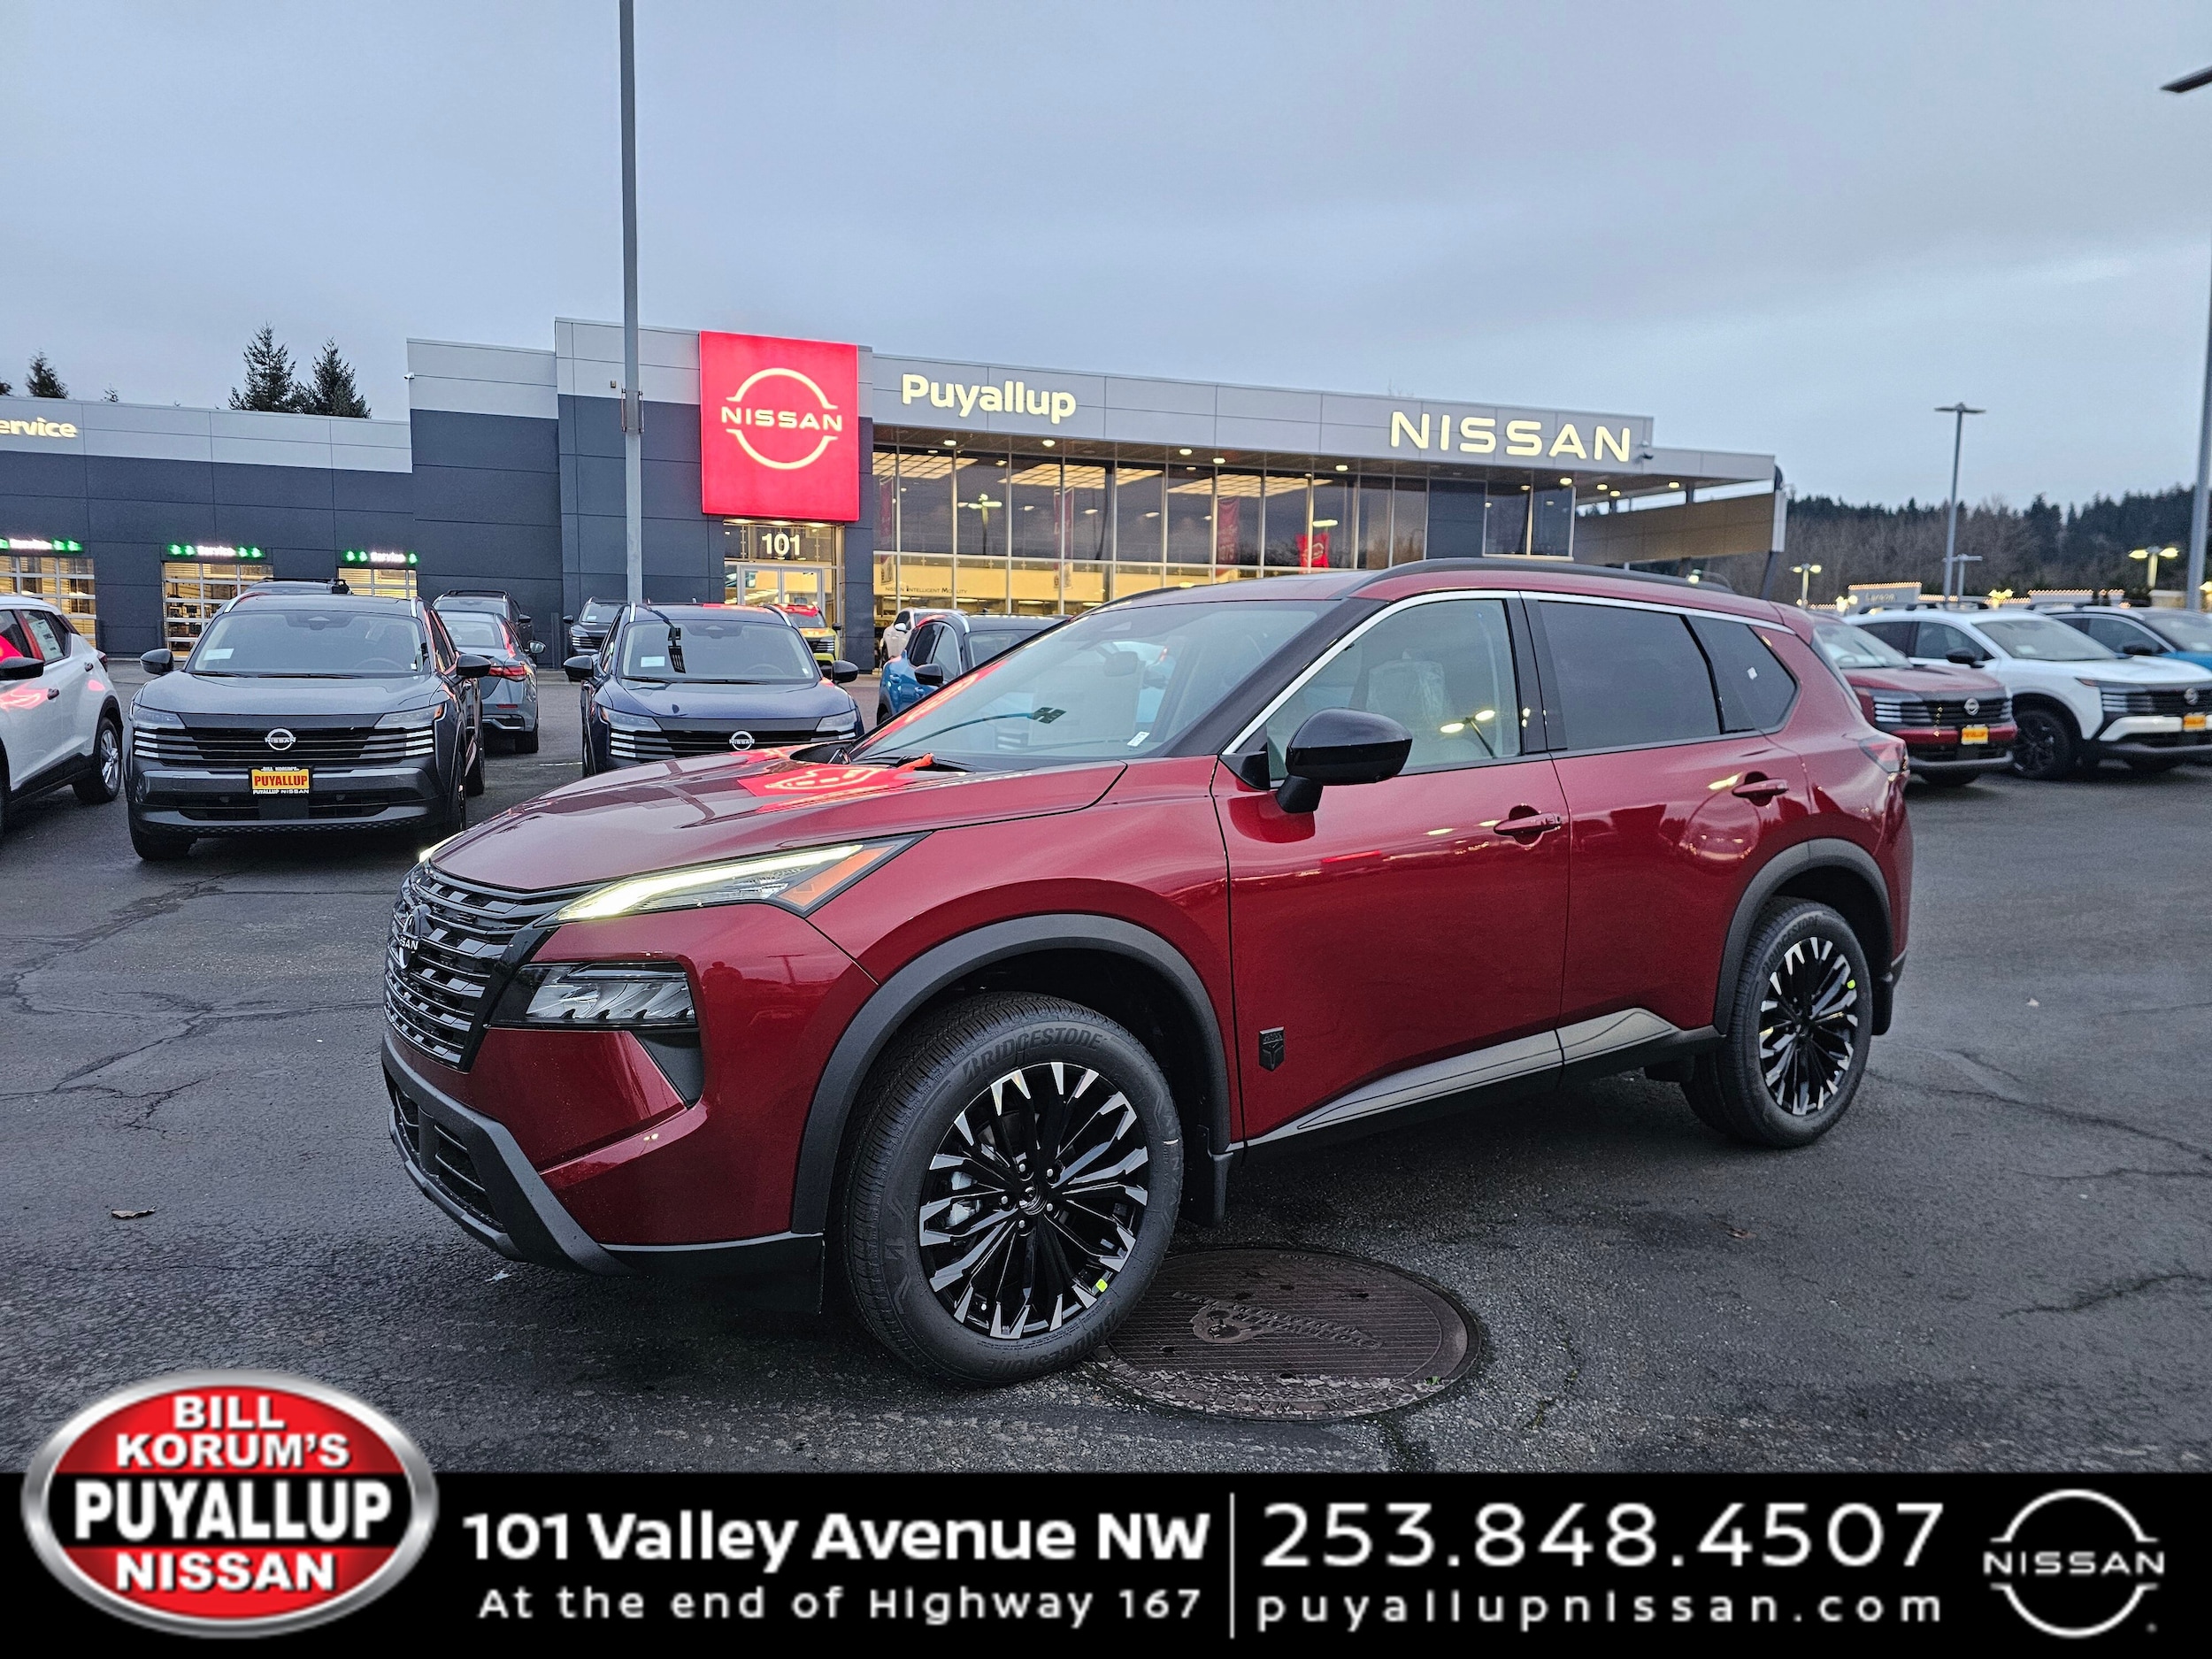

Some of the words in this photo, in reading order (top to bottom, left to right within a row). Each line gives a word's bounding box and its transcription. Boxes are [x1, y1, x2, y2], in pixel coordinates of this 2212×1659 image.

[902, 373, 1077, 424] Puyallup
[721, 406, 843, 432] NISSAN
[1390, 411, 1631, 463] NISSAN
[762, 533, 801, 556] 101
[254, 775, 308, 787] PUYALLUP
